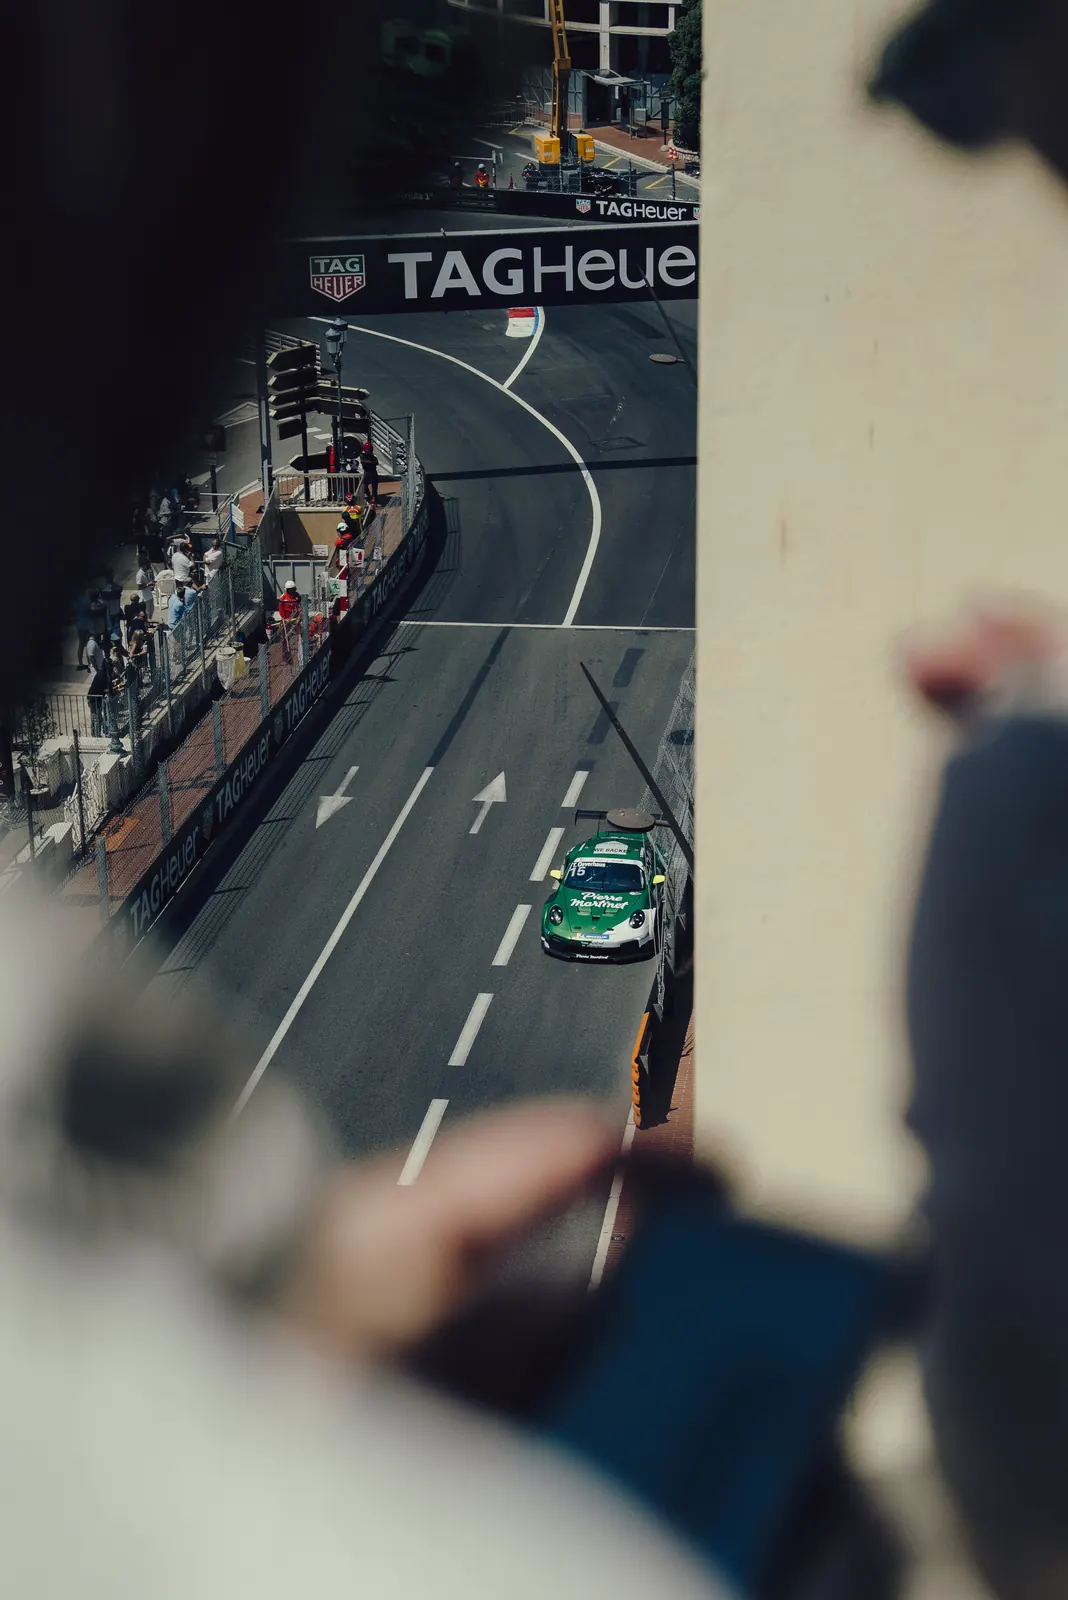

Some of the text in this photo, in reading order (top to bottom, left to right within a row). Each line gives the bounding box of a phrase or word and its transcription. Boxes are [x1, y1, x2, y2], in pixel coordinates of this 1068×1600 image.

[596, 201, 687, 220] TAGHeuer
[314, 257, 360, 273] TAG
[387, 245, 696, 299] TAGHeue
[314, 275, 362, 298] HEUER
[285, 648, 332, 730] TAGHeuer
[216, 729, 271, 824] TAGHeuer
[129, 825, 199, 938] TAGHeuer
[570, 866, 586, 877] 15
[570, 898, 629, 910] Martinet
[581, 891, 623, 901] Pierre
